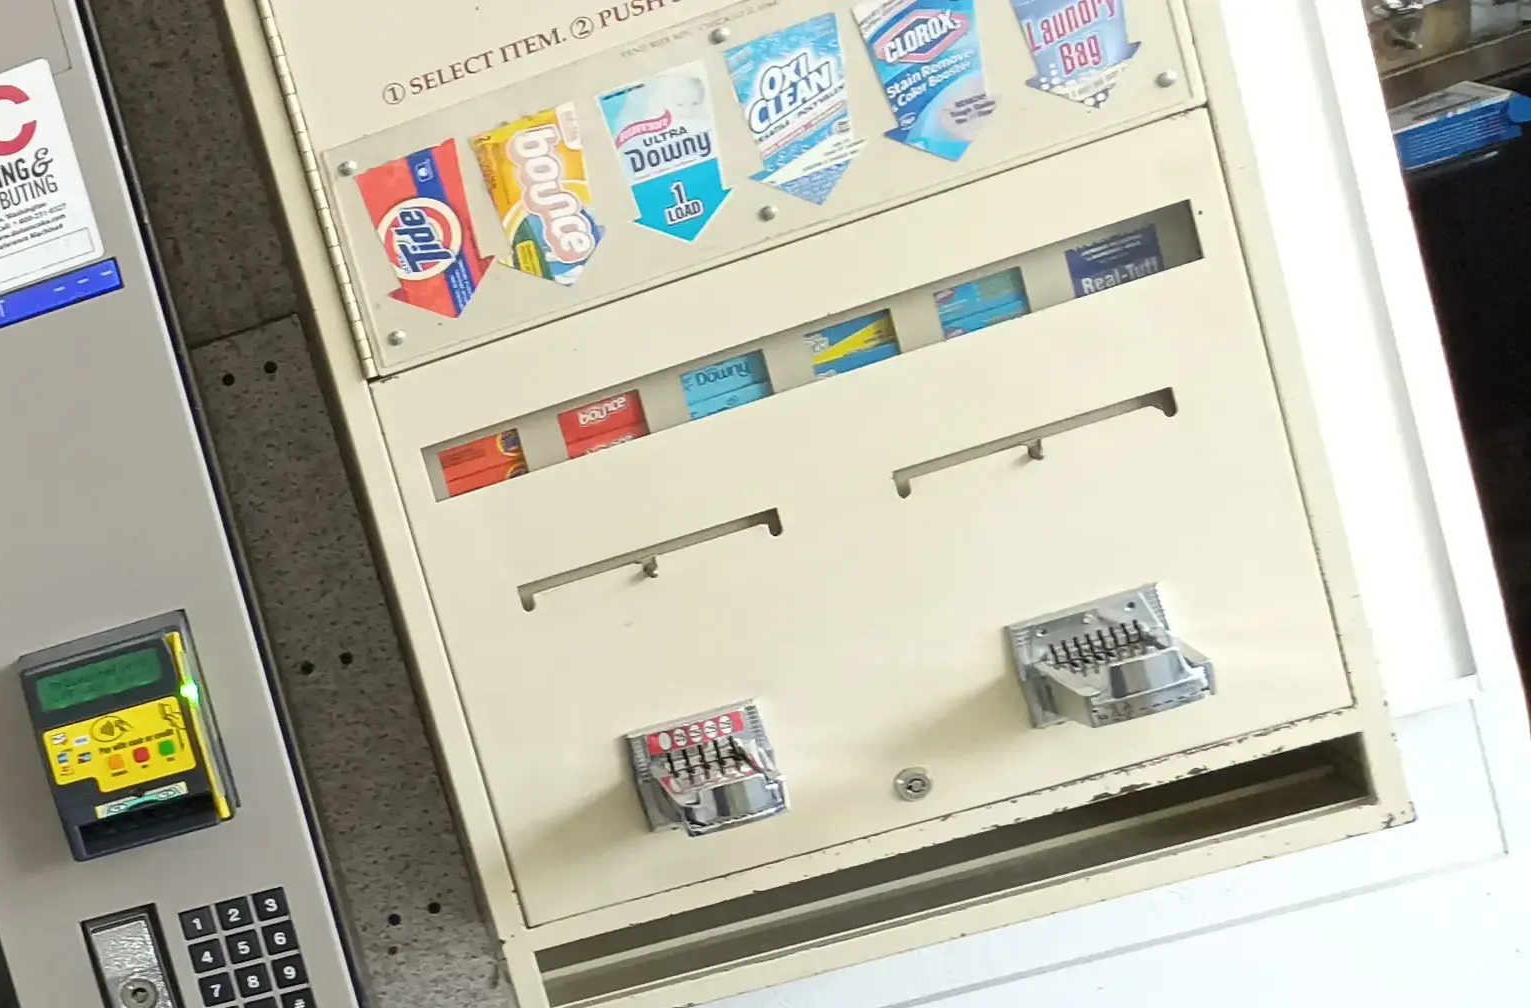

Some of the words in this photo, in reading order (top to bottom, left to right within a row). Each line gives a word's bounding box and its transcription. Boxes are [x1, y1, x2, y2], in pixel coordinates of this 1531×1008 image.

[409, 51, 494, 96] SELECT
[499, 27, 567, 63] ITEM.
[598, 0, 665, 29] PUSH
[1058, 32, 1103, 76] Bag
[749, 61, 832, 134] CLEAN
[761, 52, 808, 100] OXI
[623, 130, 713, 173] Downy
[643, 126, 688, 147] ULTRA
[507, 126, 596, 264] bounce
[666, 200, 703, 225] LOAD
[394, 205, 458, 273] Tide
[191, 916, 203, 931] 1
[228, 908, 241, 923] 2
[265, 898, 279, 913] 3
[201, 951, 214, 966] 4
[237, 941, 250, 956] 5
[273, 932, 287, 947] 6
[210, 984, 223, 999] 7
[247, 974, 260, 989] 8
[283, 965, 297, 981] 9
